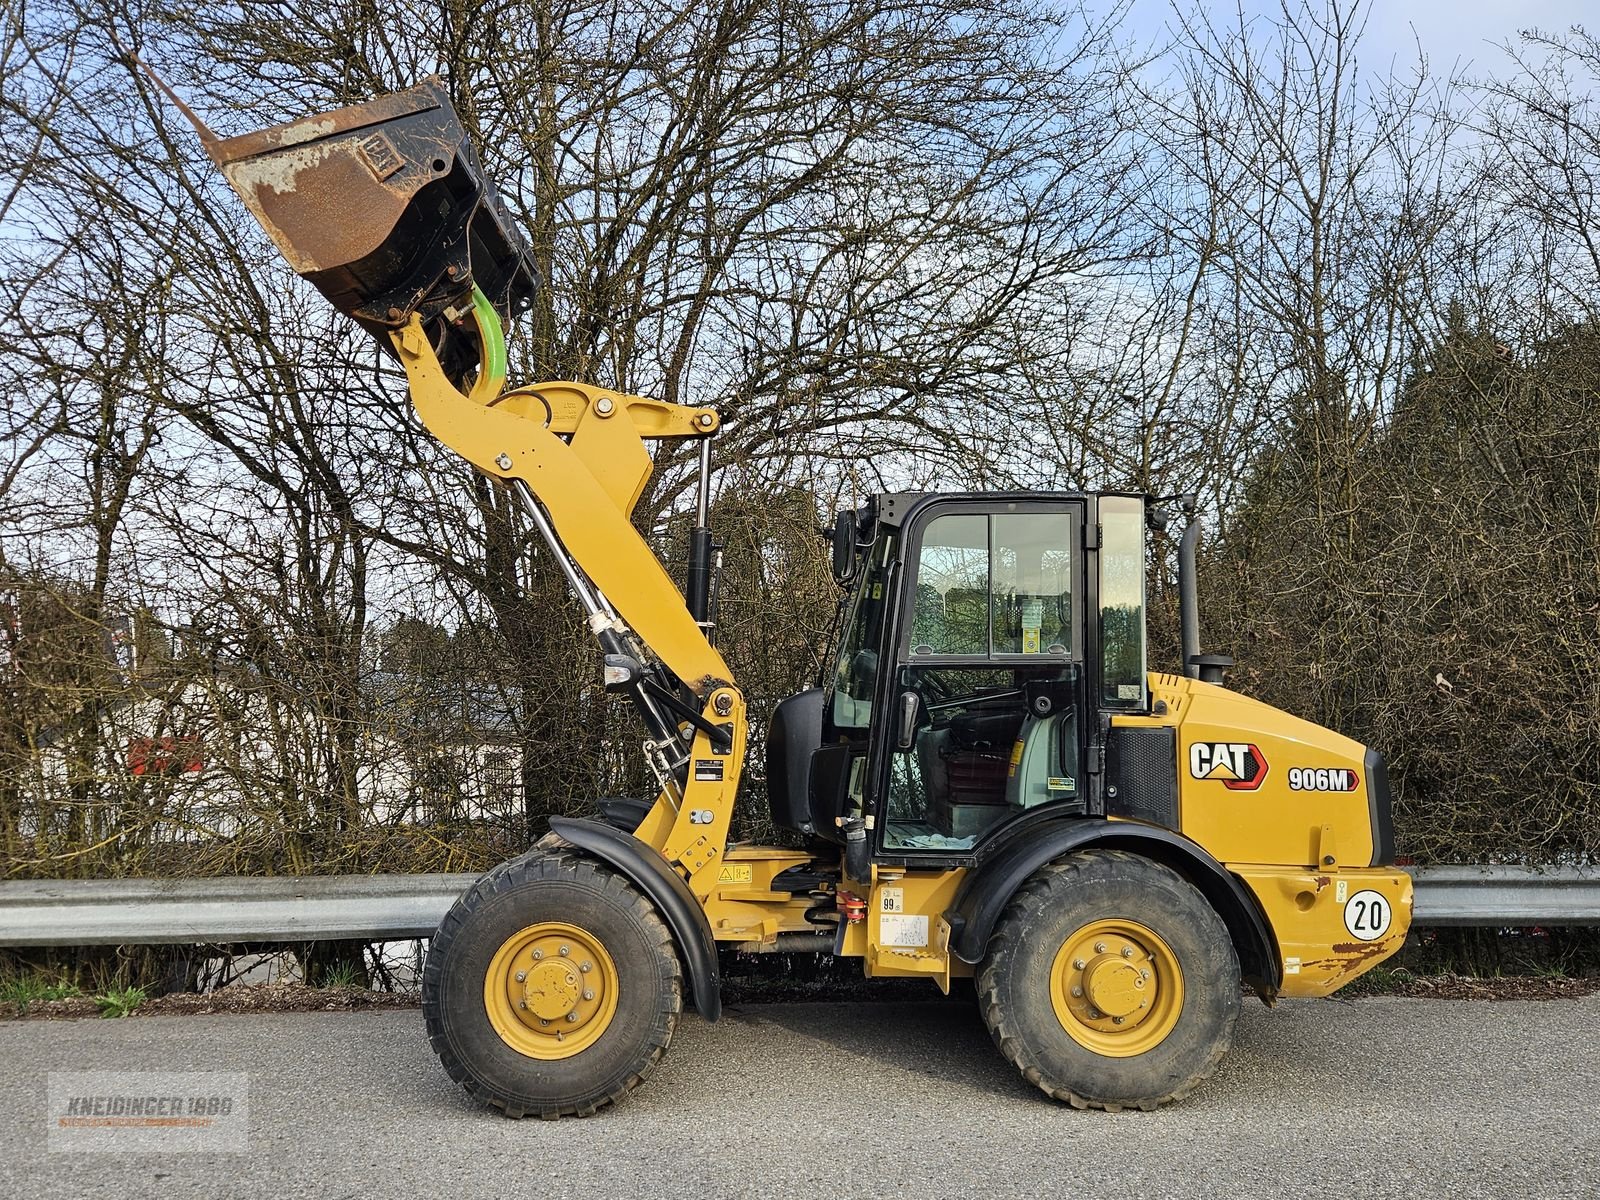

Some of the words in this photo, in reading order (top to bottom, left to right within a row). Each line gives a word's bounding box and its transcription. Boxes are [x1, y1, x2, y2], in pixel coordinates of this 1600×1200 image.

[1190, 743, 1249, 780] CAT
[1289, 768, 1348, 791] 906M
[883, 898, 894, 911] 99
[1354, 901, 1382, 930] 20
